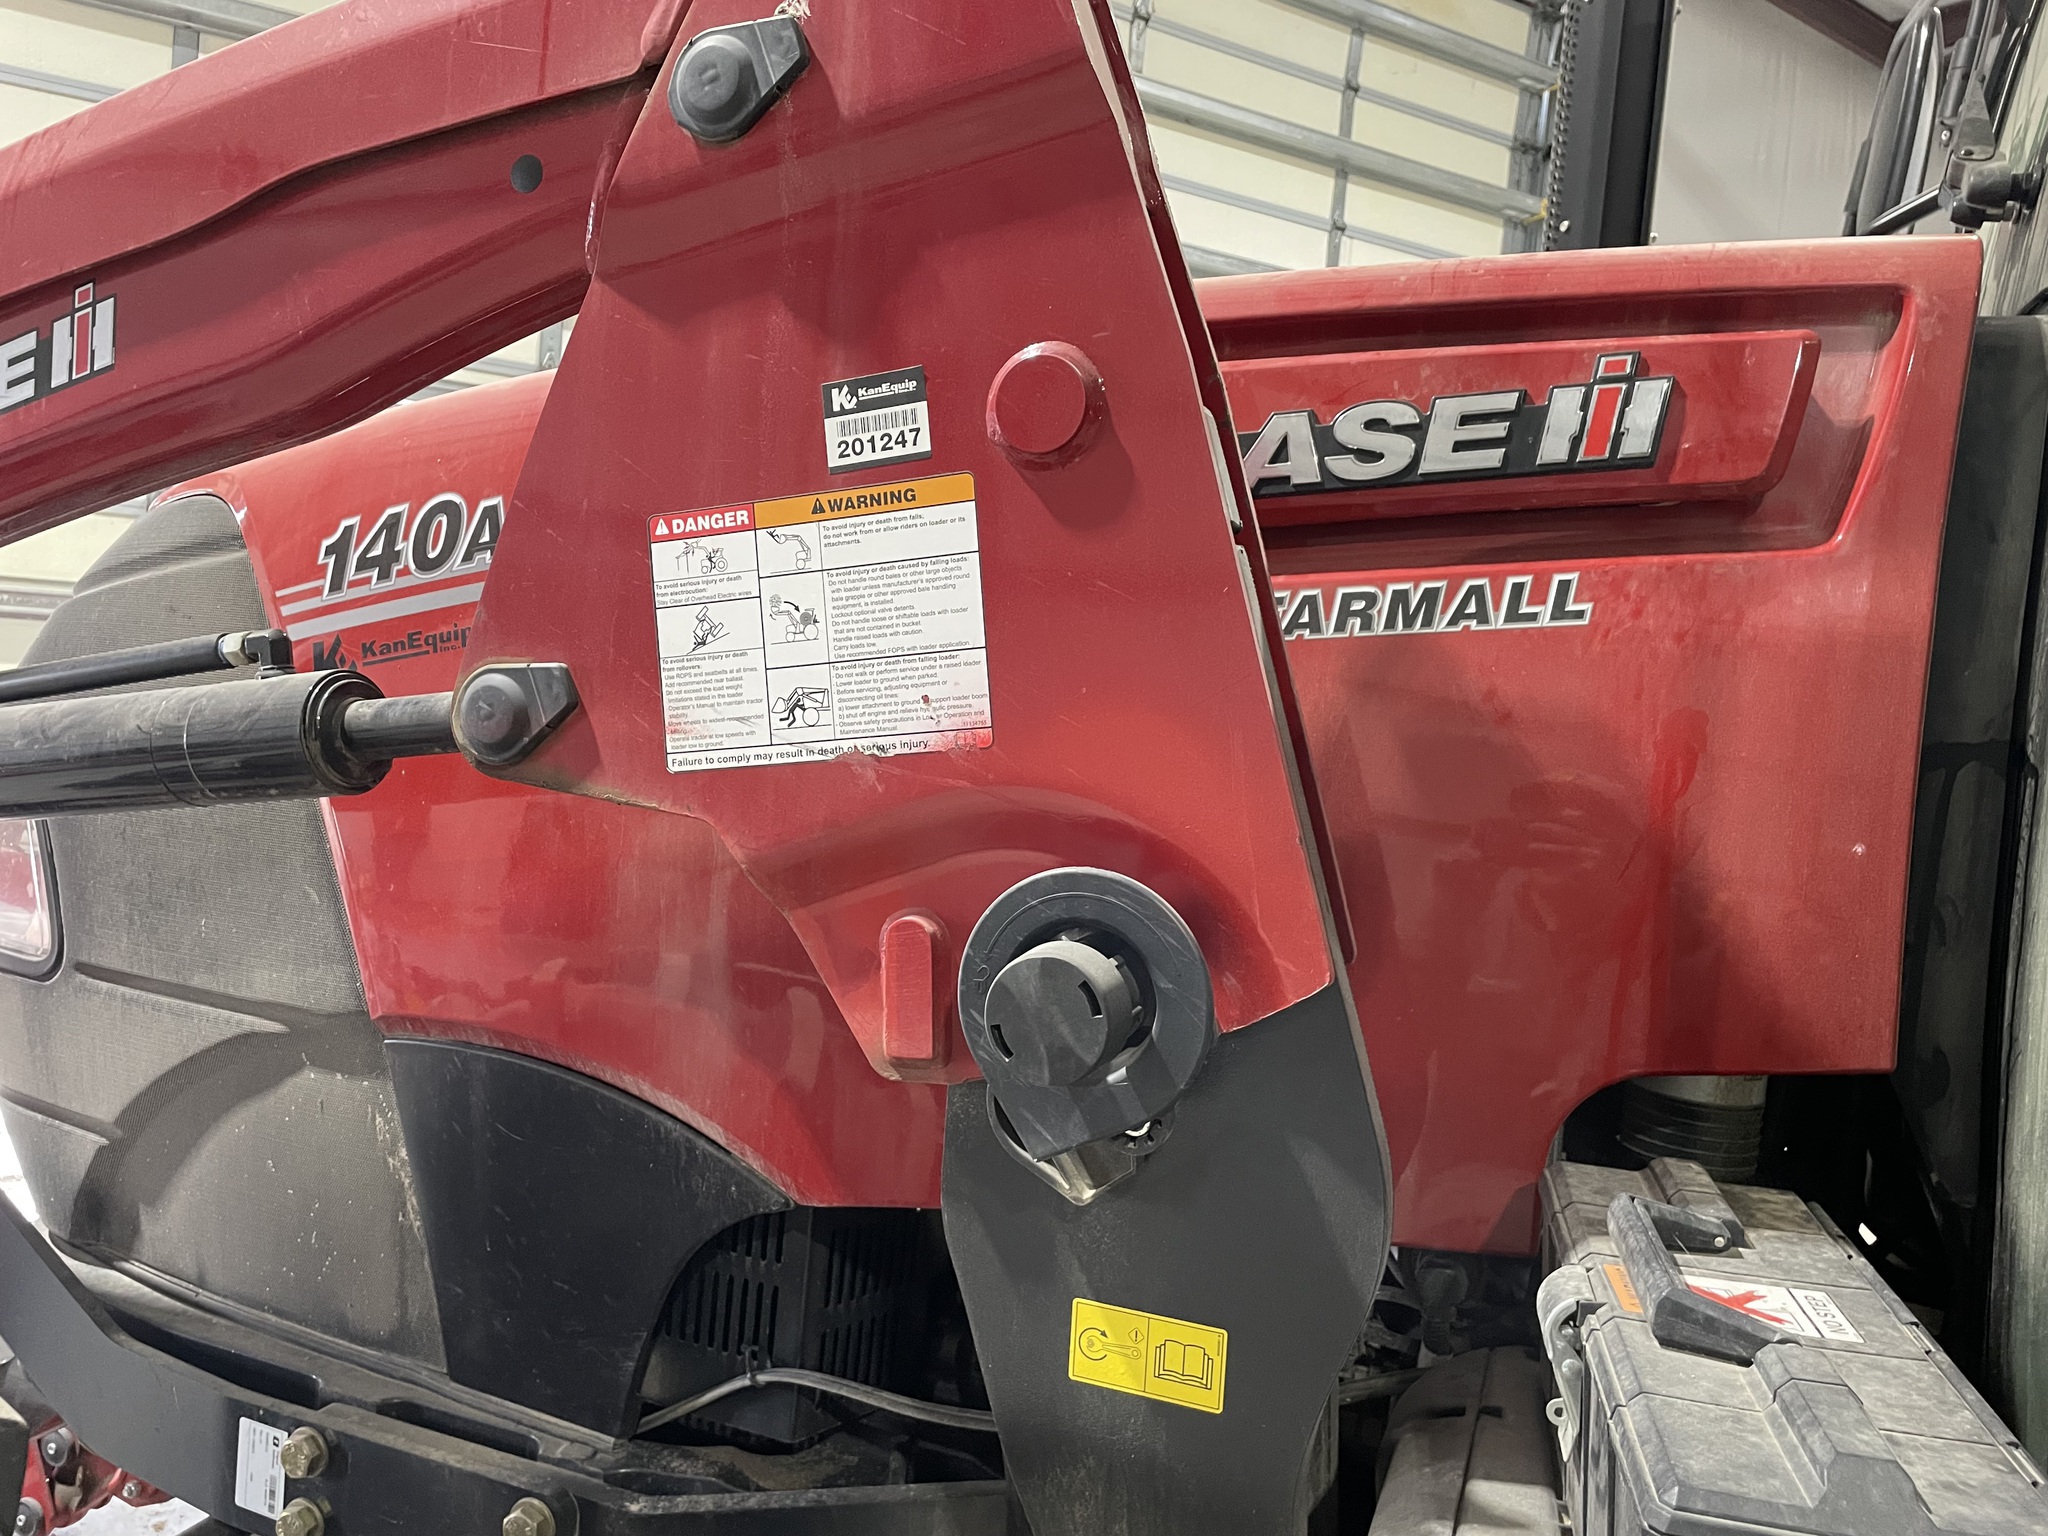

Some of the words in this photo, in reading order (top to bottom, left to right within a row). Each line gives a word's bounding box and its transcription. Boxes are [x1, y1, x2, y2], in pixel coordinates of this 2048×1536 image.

[858, 379, 918, 395] KanEquip
[837, 427, 921, 459] 201247
[1241, 391, 1523, 488] ASE
[828, 488, 917, 513] WARNING
[672, 509, 750, 535] DANGER
[843, 529, 858, 537] work
[928, 518, 948, 526] loader
[848, 521, 866, 529] injury
[874, 517, 892, 525] death
[318, 492, 506, 601] 140A
[834, 569, 851, 577] avoid
[878, 564, 896, 572] death
[897, 562, 919, 570] caused
[361, 622, 472, 659] KanEquip
[883, 658, 901, 666] death
[671, 757, 703, 766] Failure
[704, 756, 714, 764] to
[716, 752, 751, 763] comply
[752, 752, 774, 761] may
[775, 748, 803, 758] result
[804, 748, 815, 756] in
[816, 745, 845, 755] death
[899, 740, 930, 751] injury.
[1804, 1295, 1836, 1319] STEP
